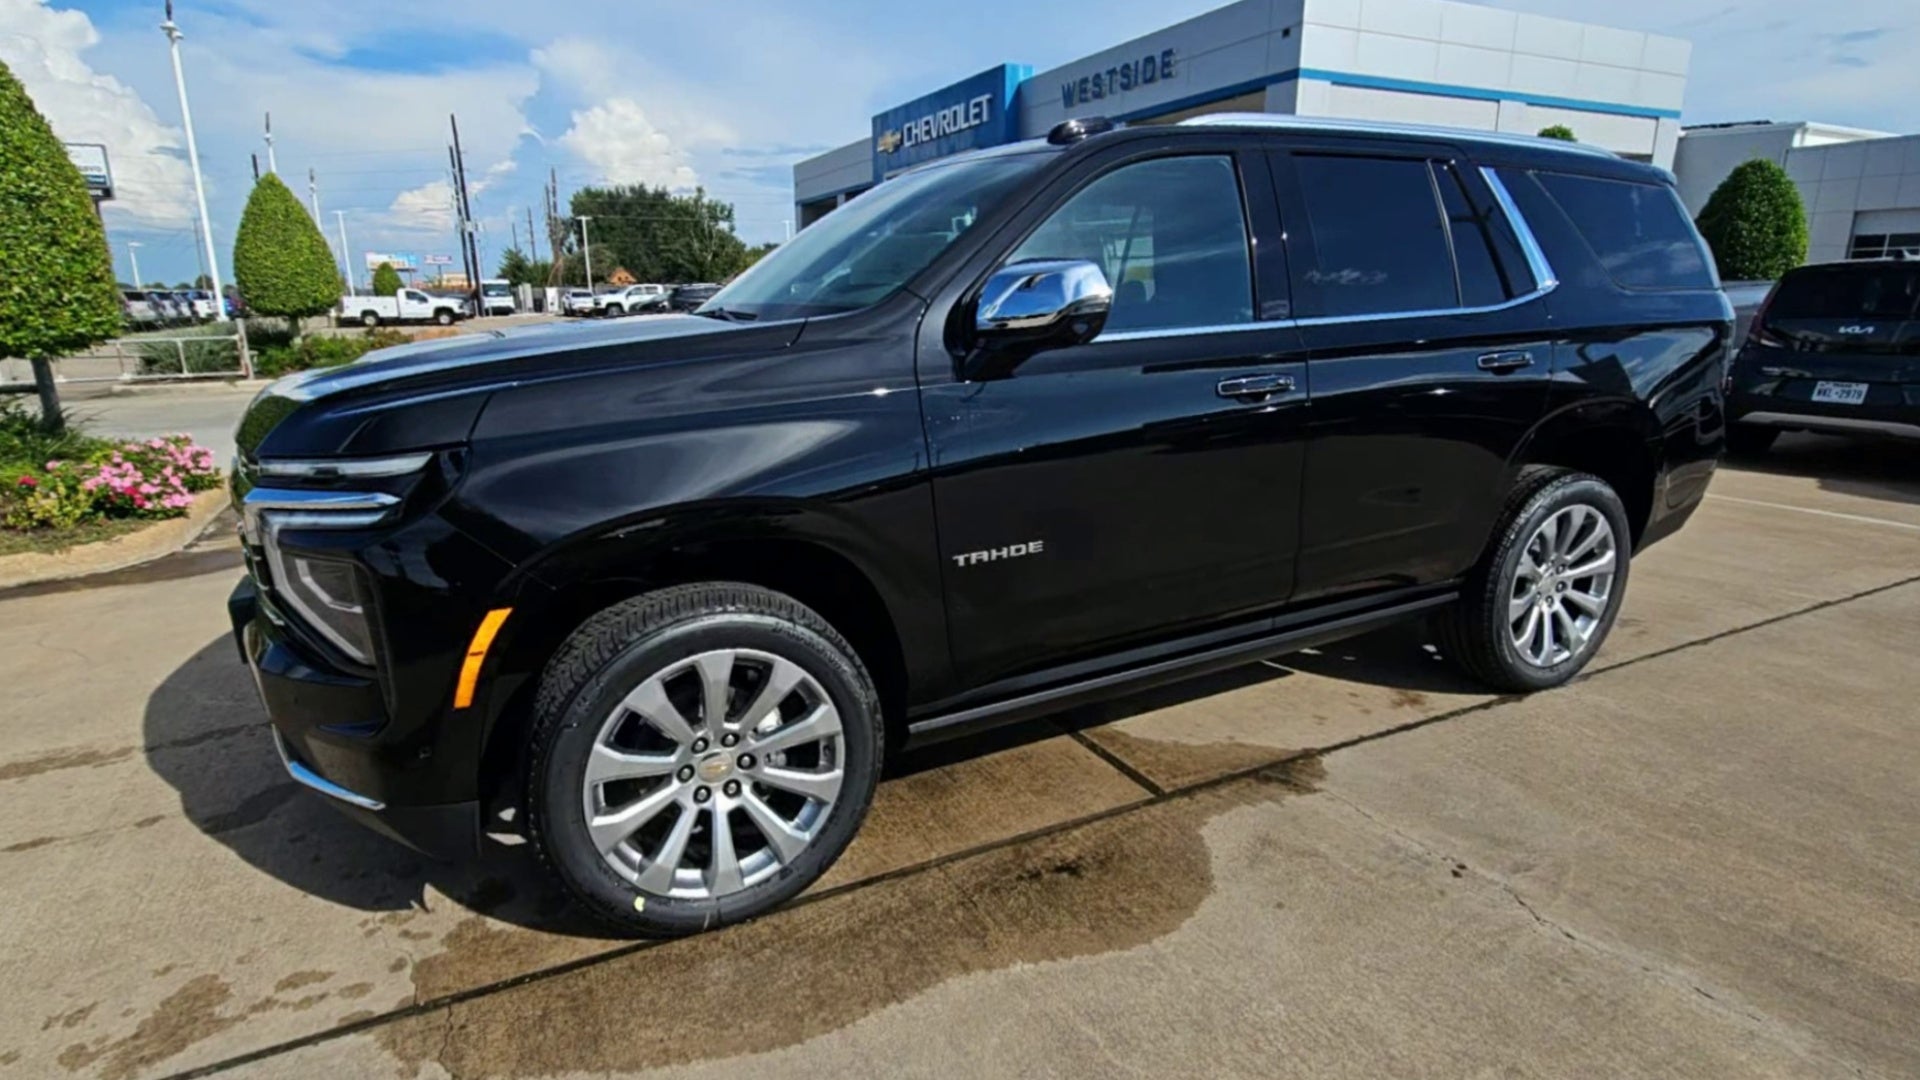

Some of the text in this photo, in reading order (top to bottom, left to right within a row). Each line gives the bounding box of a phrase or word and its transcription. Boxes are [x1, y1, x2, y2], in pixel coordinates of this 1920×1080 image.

[1061, 48, 1175, 109] WESTSIDE
[903, 93, 992, 147] CHEVROLET
[952, 540, 1044, 567] TAHOE
